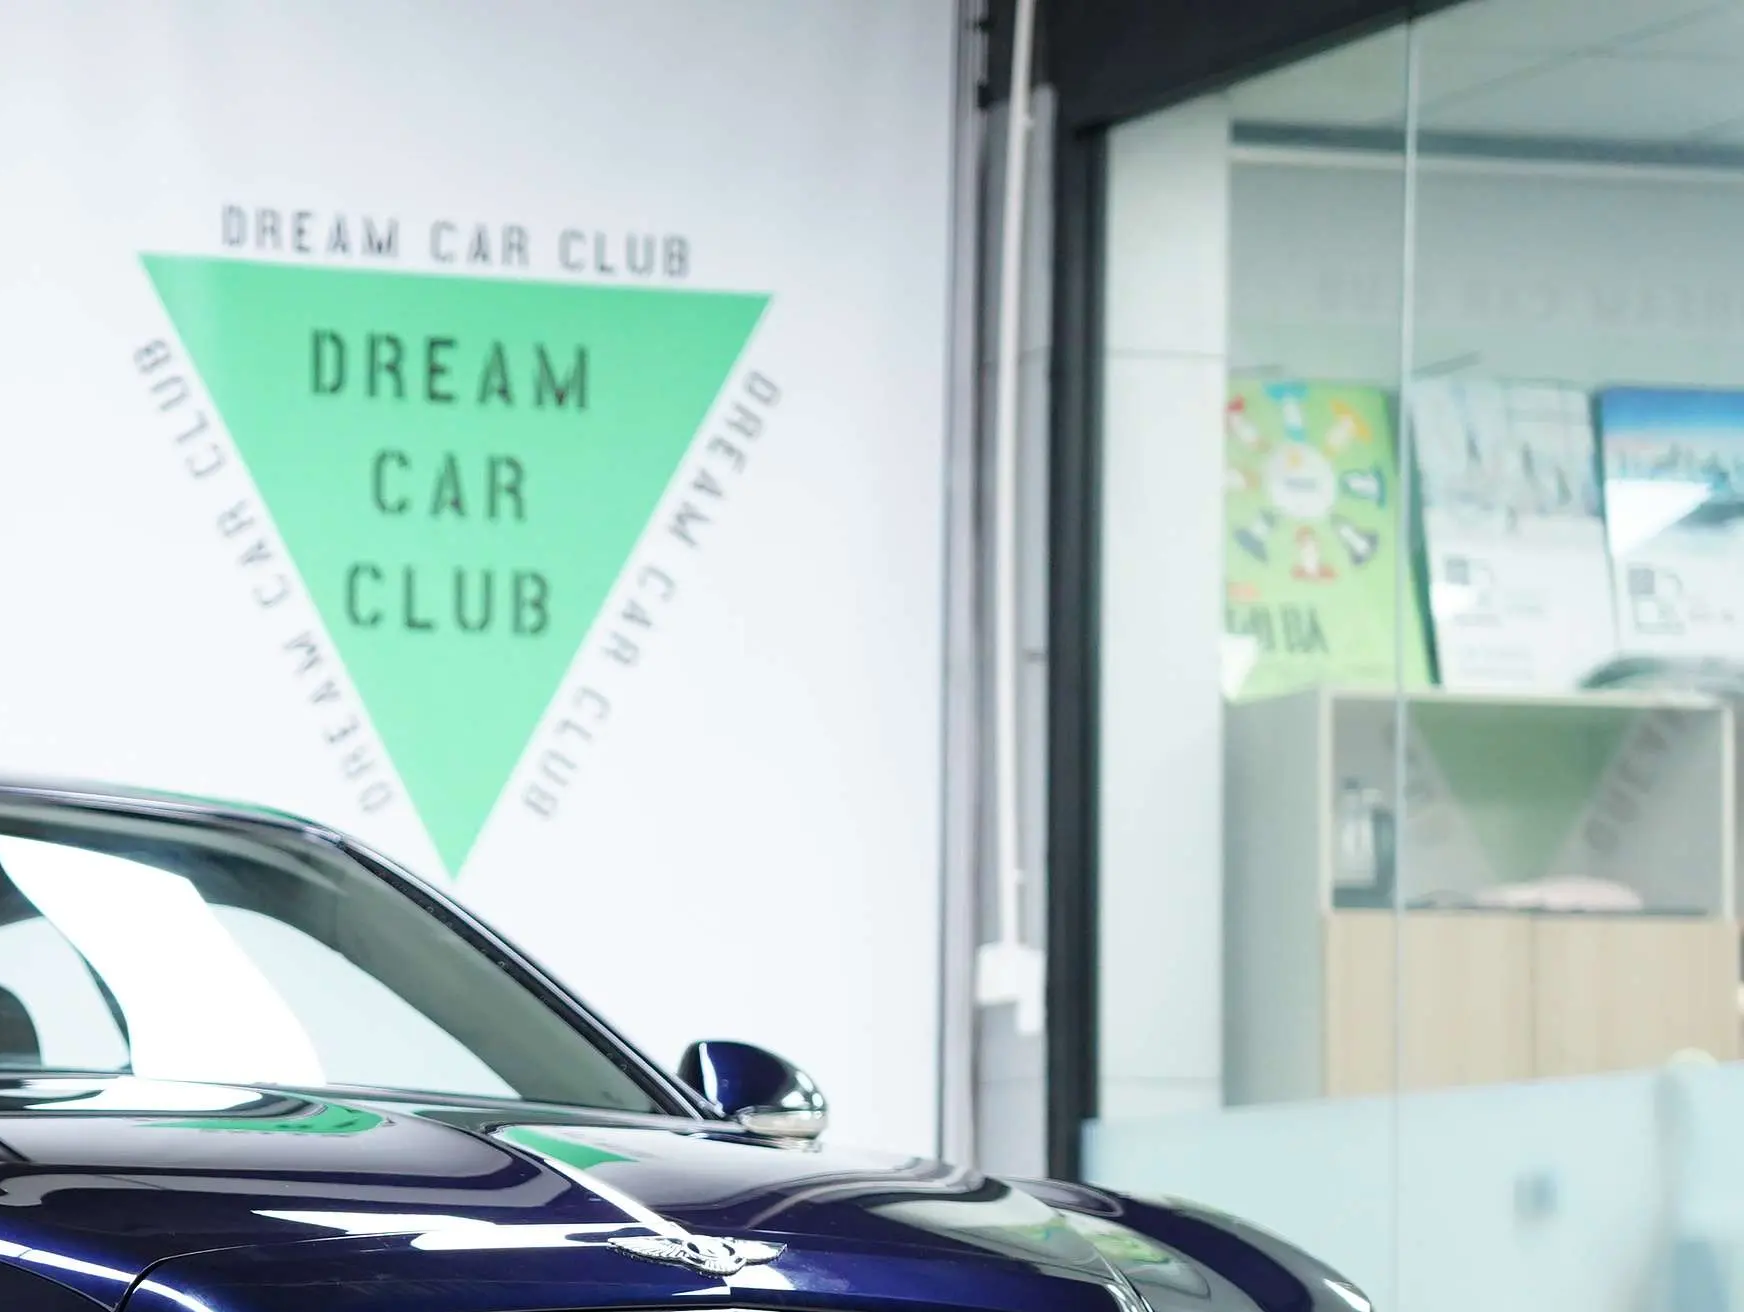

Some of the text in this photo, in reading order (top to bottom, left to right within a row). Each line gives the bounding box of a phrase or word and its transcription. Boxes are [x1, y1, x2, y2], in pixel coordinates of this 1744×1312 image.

[221, 204, 691, 279] DREAM CAR CLUB
[132, 338, 227, 480] CLUB
[311, 329, 591, 412] DREAM
[371, 448, 527, 523] CAR
[216, 497, 292, 611] CAR
[345, 562, 551, 637] CLUB
[521, 370, 781, 822] DREAM CAR CLUB
